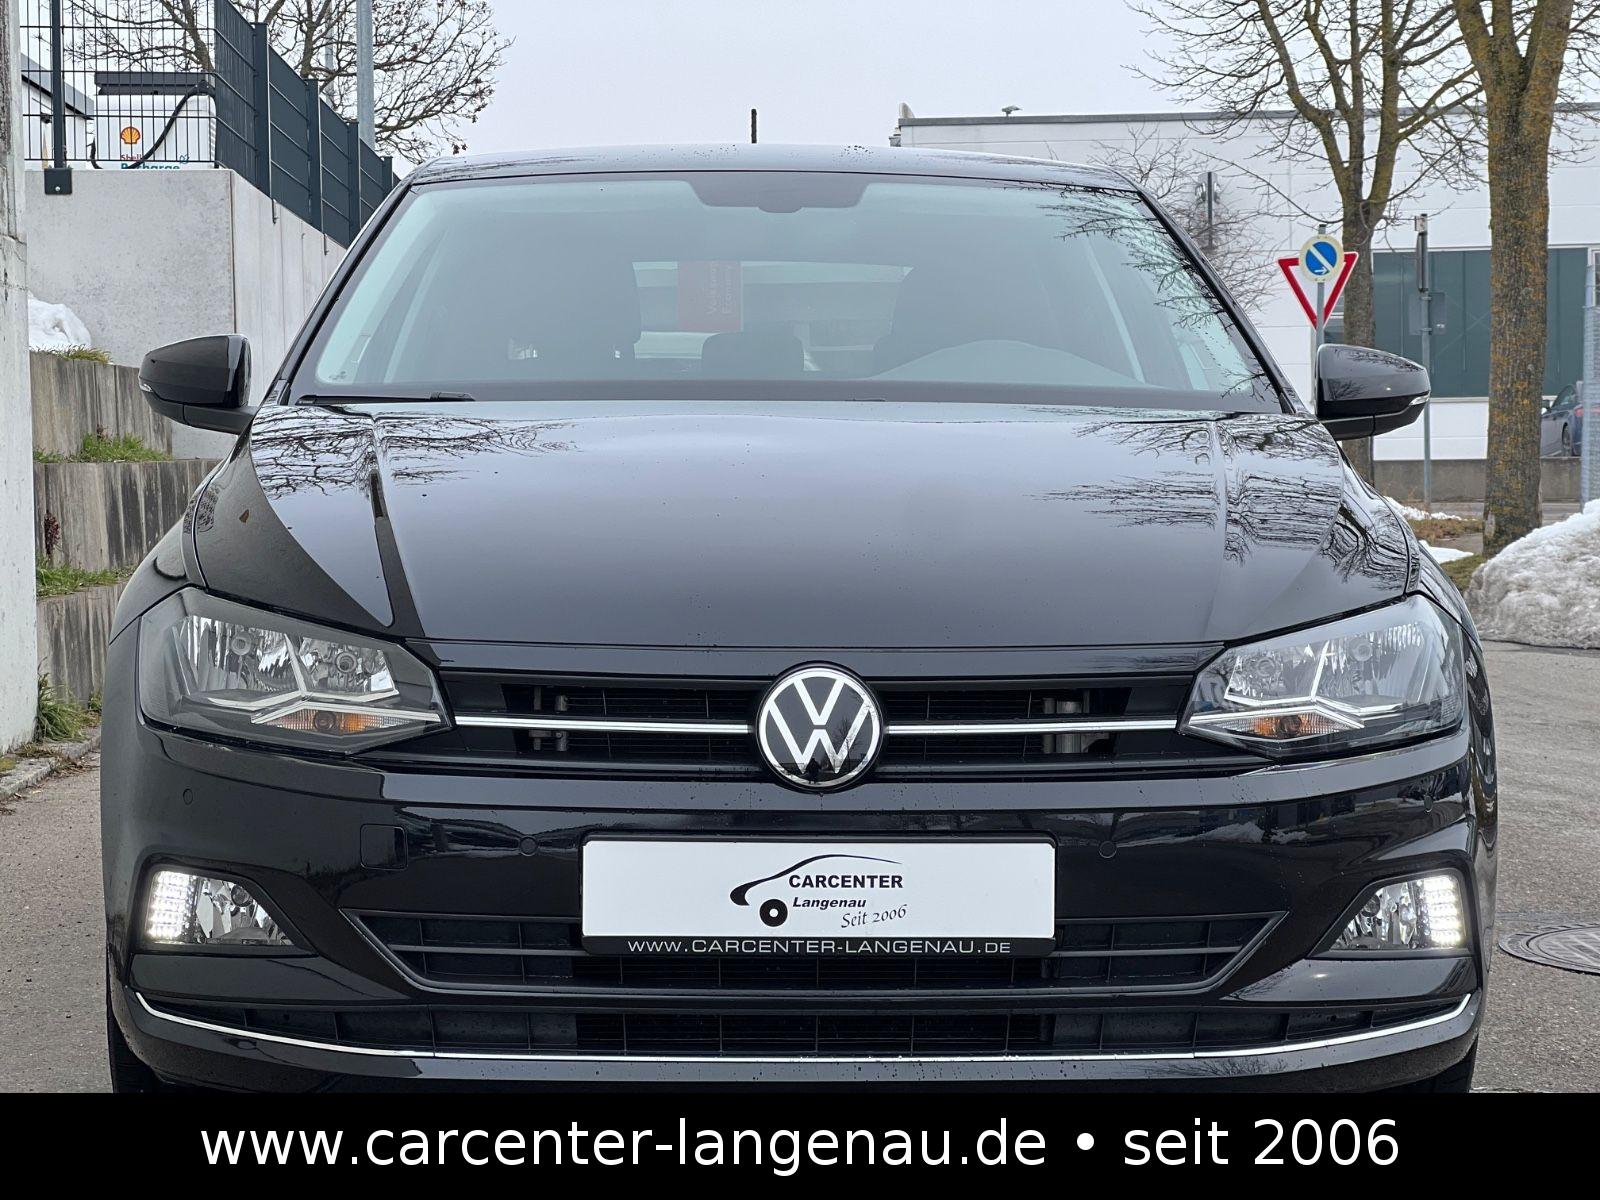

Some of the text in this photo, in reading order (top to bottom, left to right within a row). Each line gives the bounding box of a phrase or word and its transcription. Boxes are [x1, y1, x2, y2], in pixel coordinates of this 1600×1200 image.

[764, 675, 875, 777] VW
[788, 874, 903, 889] CARCENTER
[792, 896, 867, 910] Langenau
[840, 904, 907, 928] Seit 2006
[627, 939, 1011, 954] WWW.CARCENTER-LANGENAU.DE
